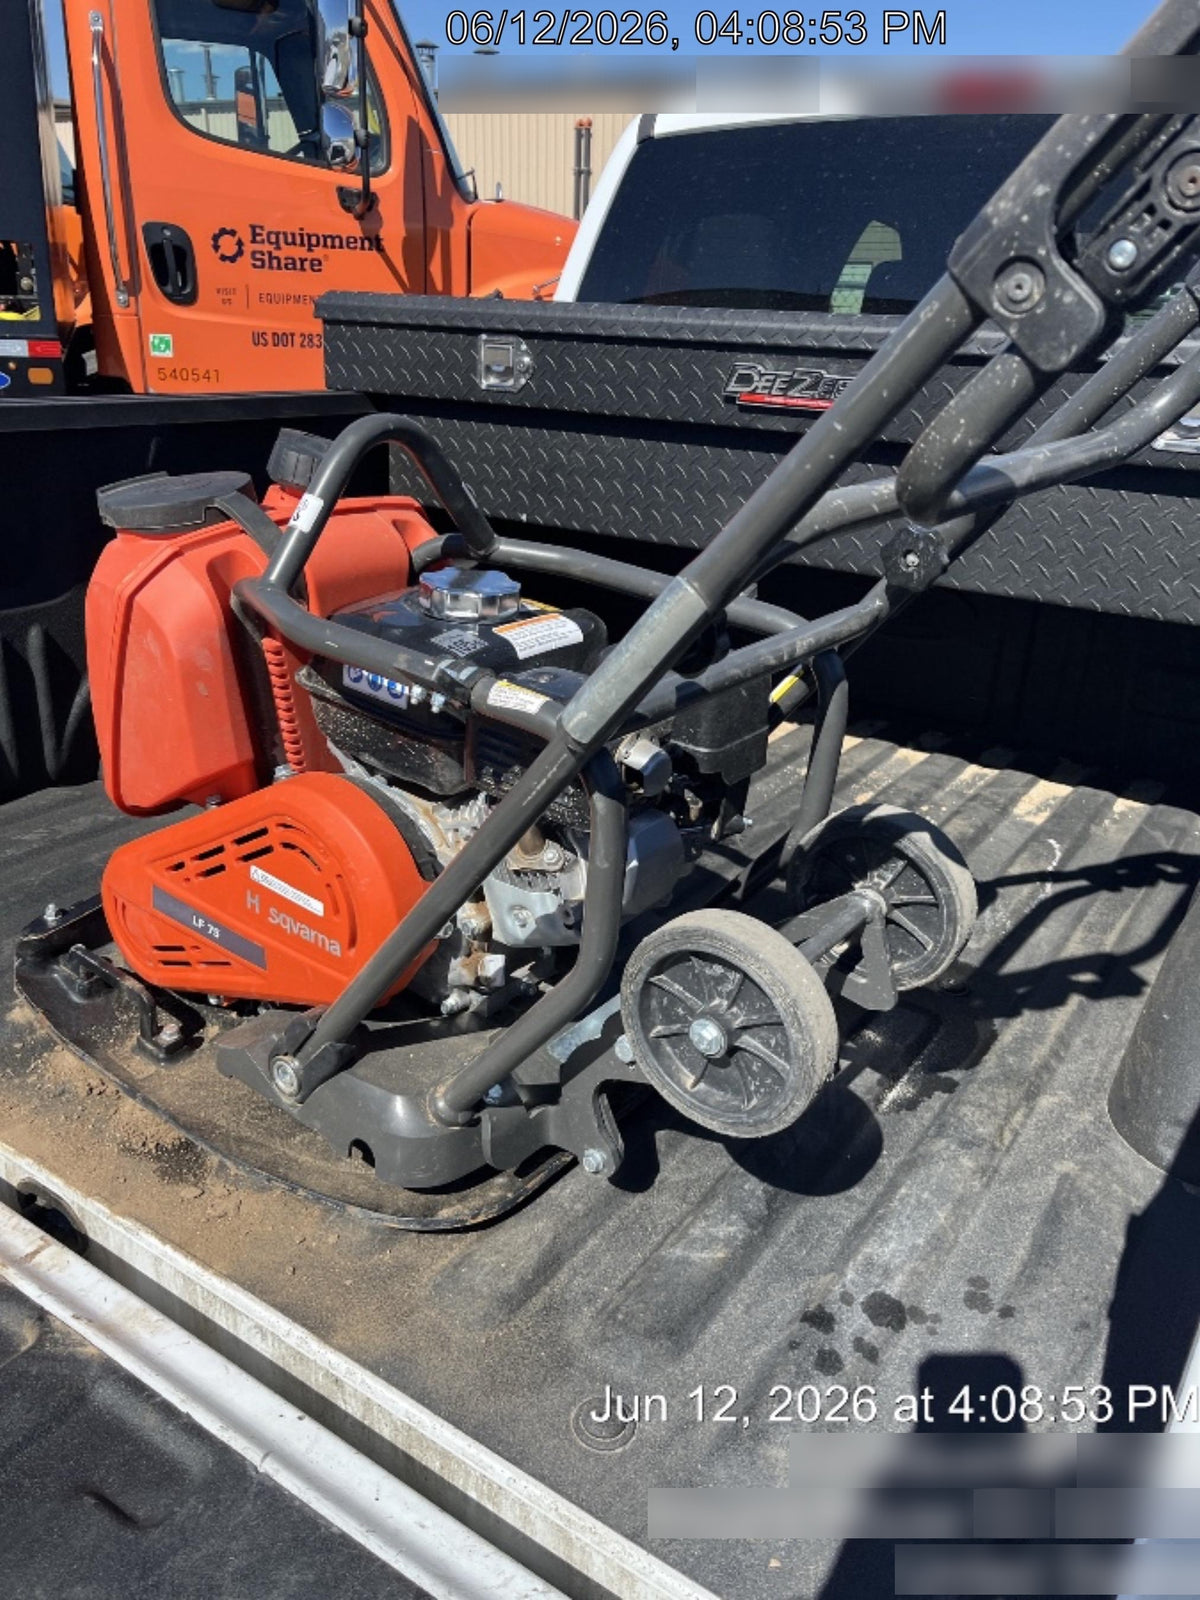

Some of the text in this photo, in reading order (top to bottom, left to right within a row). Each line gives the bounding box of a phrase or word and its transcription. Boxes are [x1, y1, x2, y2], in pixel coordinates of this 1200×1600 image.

[249, 224, 384, 252] Equipment
[250, 250, 323, 273] Share
[251, 331, 268, 347] US
[271, 332, 296, 348] DOT
[157, 367, 220, 383] 540541
[193, 915, 206, 929] LF
